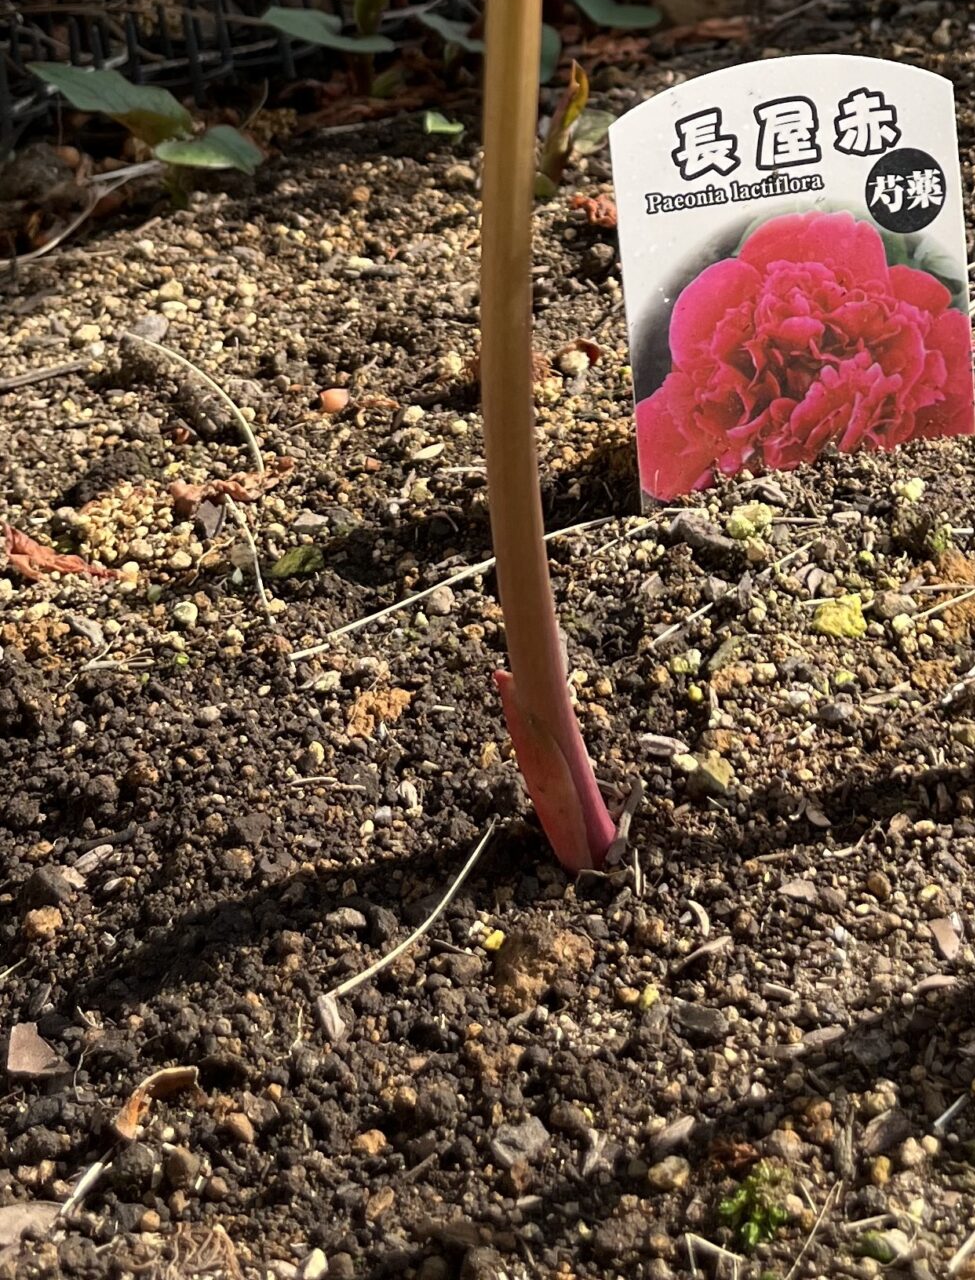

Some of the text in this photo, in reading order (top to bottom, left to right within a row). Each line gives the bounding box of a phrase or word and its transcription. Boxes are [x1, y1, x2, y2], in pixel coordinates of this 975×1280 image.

[671, 86, 902, 180] 長屋赤
[646, 174, 824, 214] Paeonia lactiflora
[868, 168, 944, 213] 芍薬
